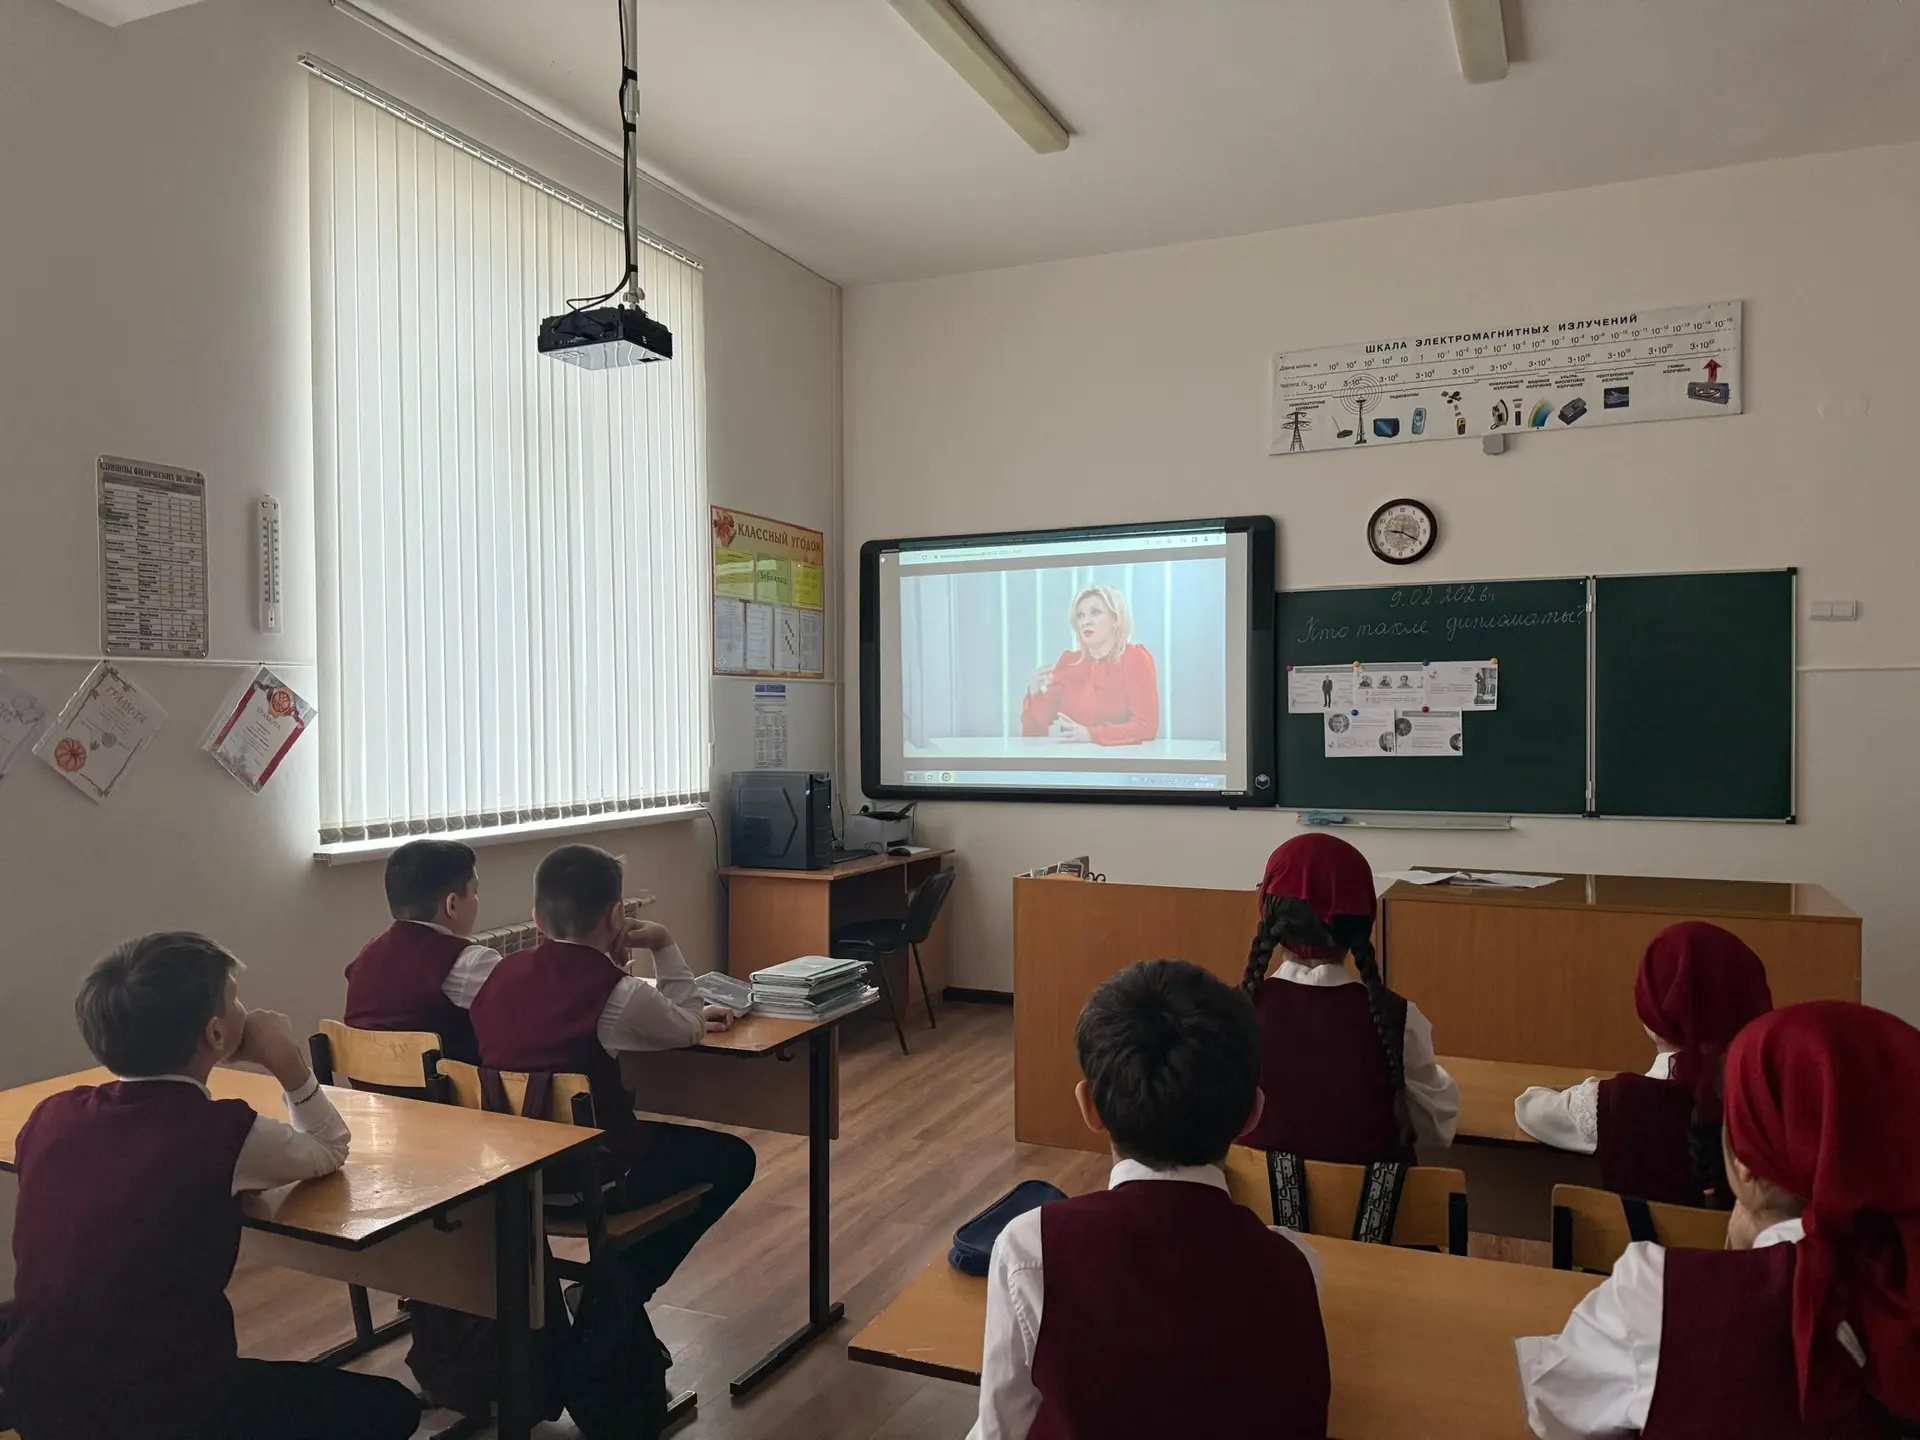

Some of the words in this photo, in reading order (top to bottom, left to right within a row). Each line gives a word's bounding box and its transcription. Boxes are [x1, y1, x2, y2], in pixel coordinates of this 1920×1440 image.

[1365, 341, 1408, 354] ШКАЛА
[1415, 325, 1550, 347] ЭЛЕКТРОМАГНИТНЫХ
[1558, 313, 1638, 331] ИЗЛУЧЕНИЙ
[738, 524, 788, 546] КЛАССНЫЙ
[1297, 616, 1350, 643] Кто
[1356, 620, 1430, 637] такие
[104, 686, 148, 724] ГРАМОТА
[256, 706, 281, 731] ГРАМОТА
